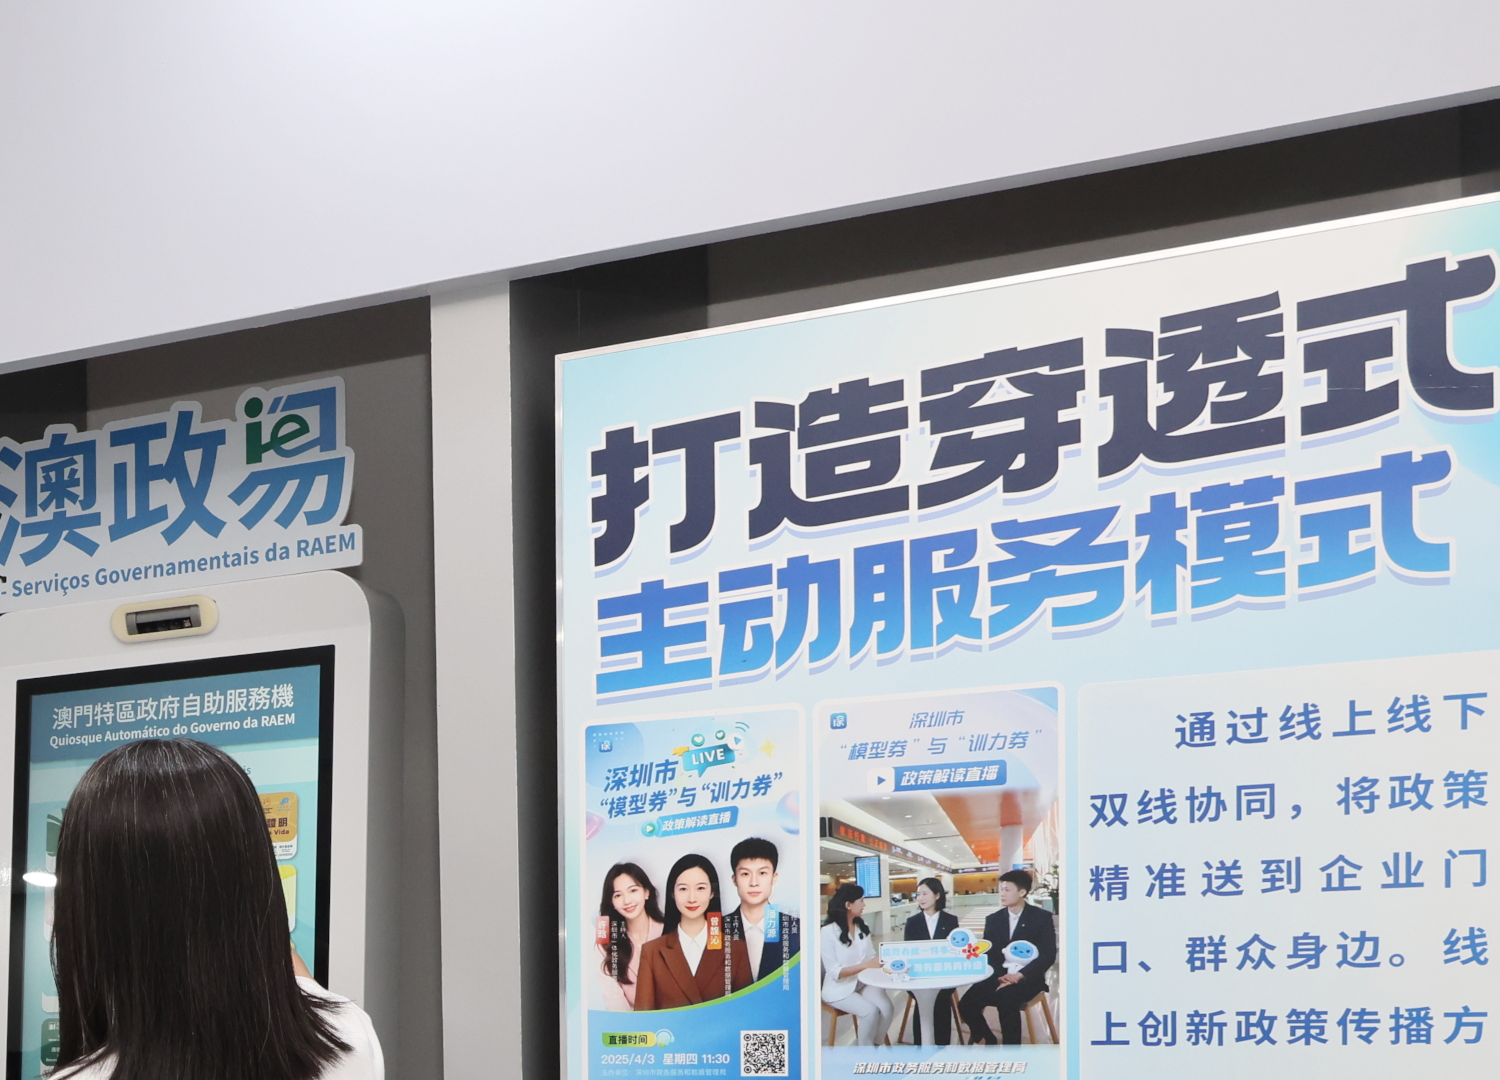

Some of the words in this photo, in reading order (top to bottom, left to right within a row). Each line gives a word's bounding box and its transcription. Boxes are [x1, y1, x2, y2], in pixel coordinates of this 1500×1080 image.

[591, 256, 1500, 567] 打造穿透式
[11, 572, 90, 598] Serviços
[95, 545, 260, 586] Governamentais
[265, 541, 290, 563] da
[297, 531, 356, 559] RAEM
[595, 450, 1453, 697] 主动服务模式
[52, 684, 295, 730] 澳門特區政府自助服務機
[909, 710, 965, 729] 深圳市
[1175, 692, 1489, 749] 通过线上线下
[49, 733, 102, 749] Quiosque
[104, 726, 170, 743] Automático
[172, 723, 189, 736] do
[190, 718, 241, 733] Governo
[242, 716, 259, 730] da
[260, 713, 295, 728] RAEM
[603, 759, 679, 793] 深圳市
[691, 749, 725, 765] LIVE
[900, 765, 1000, 786] 政策解读直播
[600, 772, 783, 819] “模型券”与“训力券”
[1088, 769, 1489, 828] 双线协同，将政策
[661, 811, 731, 831] 政策解读直播
[1088, 849, 1488, 902] 精准送到企业门
[1091, 927, 1489, 974] 口、群众身边。线
[608, 1034, 648, 1045] 直播时间
[1090, 1005, 1489, 1047] 上创新政策传播方
[601, 1054, 655, 1065] 2025/4/3
[662, 1053, 698, 1065] 星期四
[701, 1053, 730, 1064] 11:30
[853, 1062, 1028, 1075] 深圳市政务服务和数据管理局
